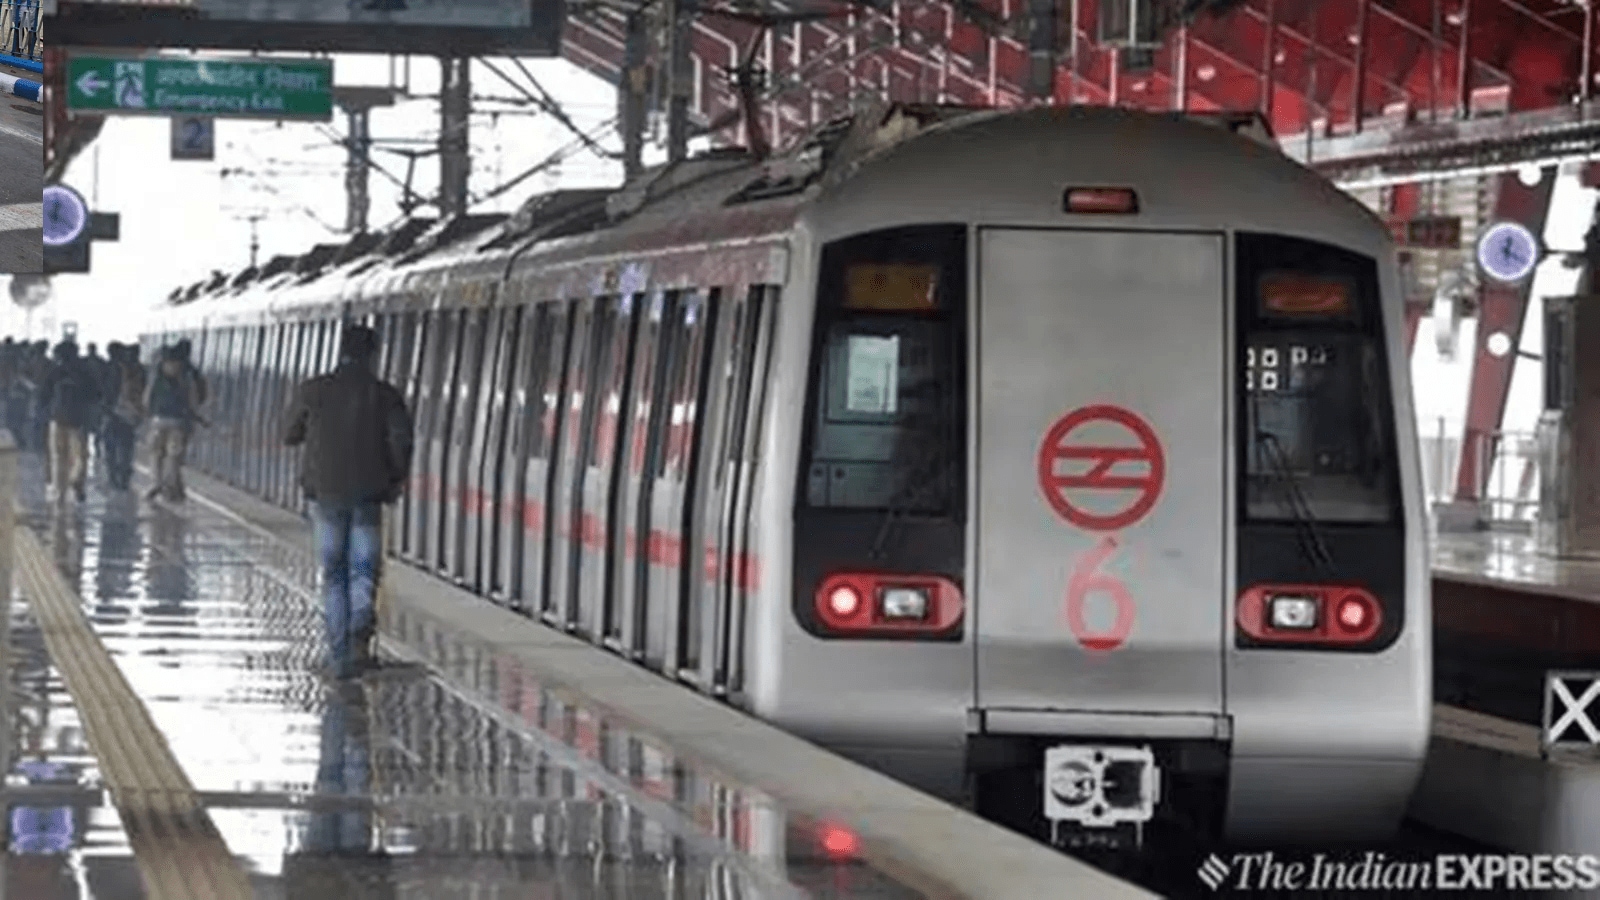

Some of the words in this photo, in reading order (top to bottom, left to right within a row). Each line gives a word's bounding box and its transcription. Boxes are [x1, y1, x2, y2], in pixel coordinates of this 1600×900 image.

[154, 89, 248, 110] Emergency
[182, 119, 203, 150] 2
[1066, 536, 1137, 650] 6
